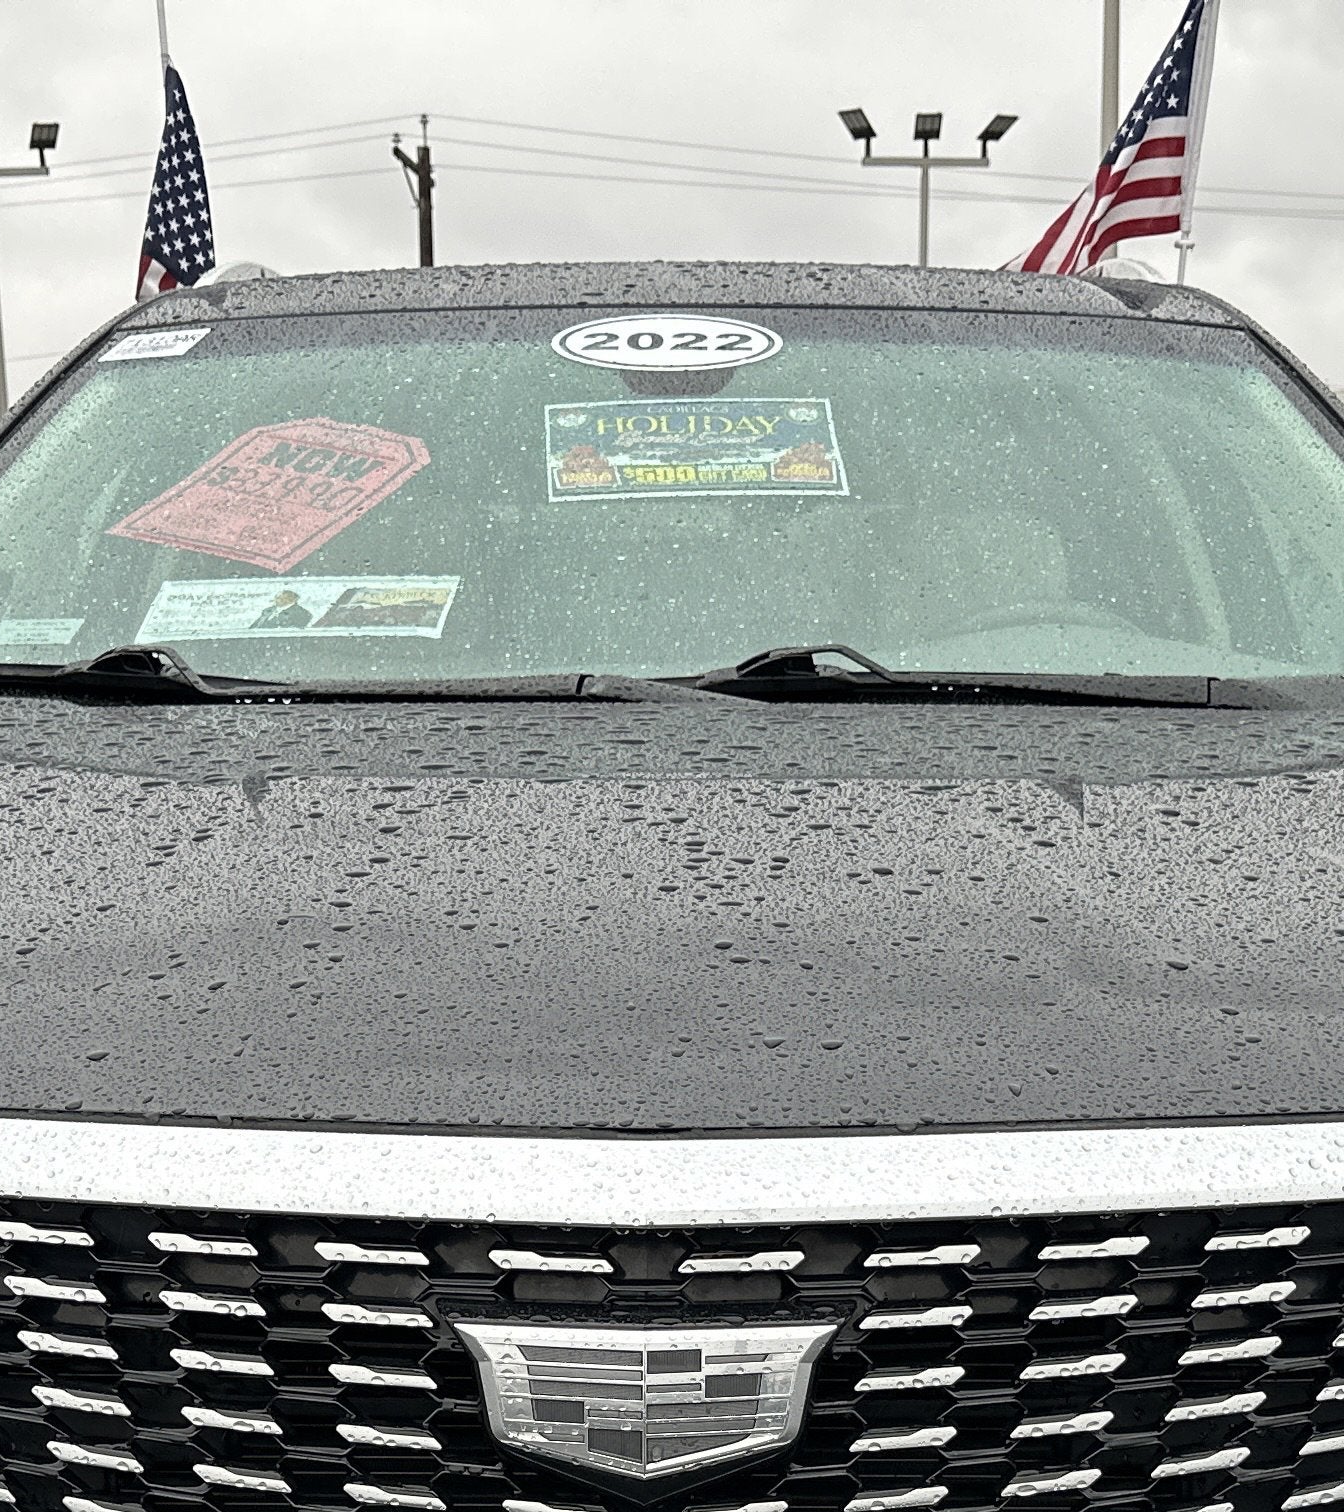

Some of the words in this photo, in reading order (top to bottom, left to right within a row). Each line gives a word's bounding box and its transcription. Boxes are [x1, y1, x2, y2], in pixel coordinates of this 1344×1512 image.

[581, 332, 753, 351] 2022
[597, 415, 783, 436] HOLIDAY
[258, 441, 385, 482] NOW
